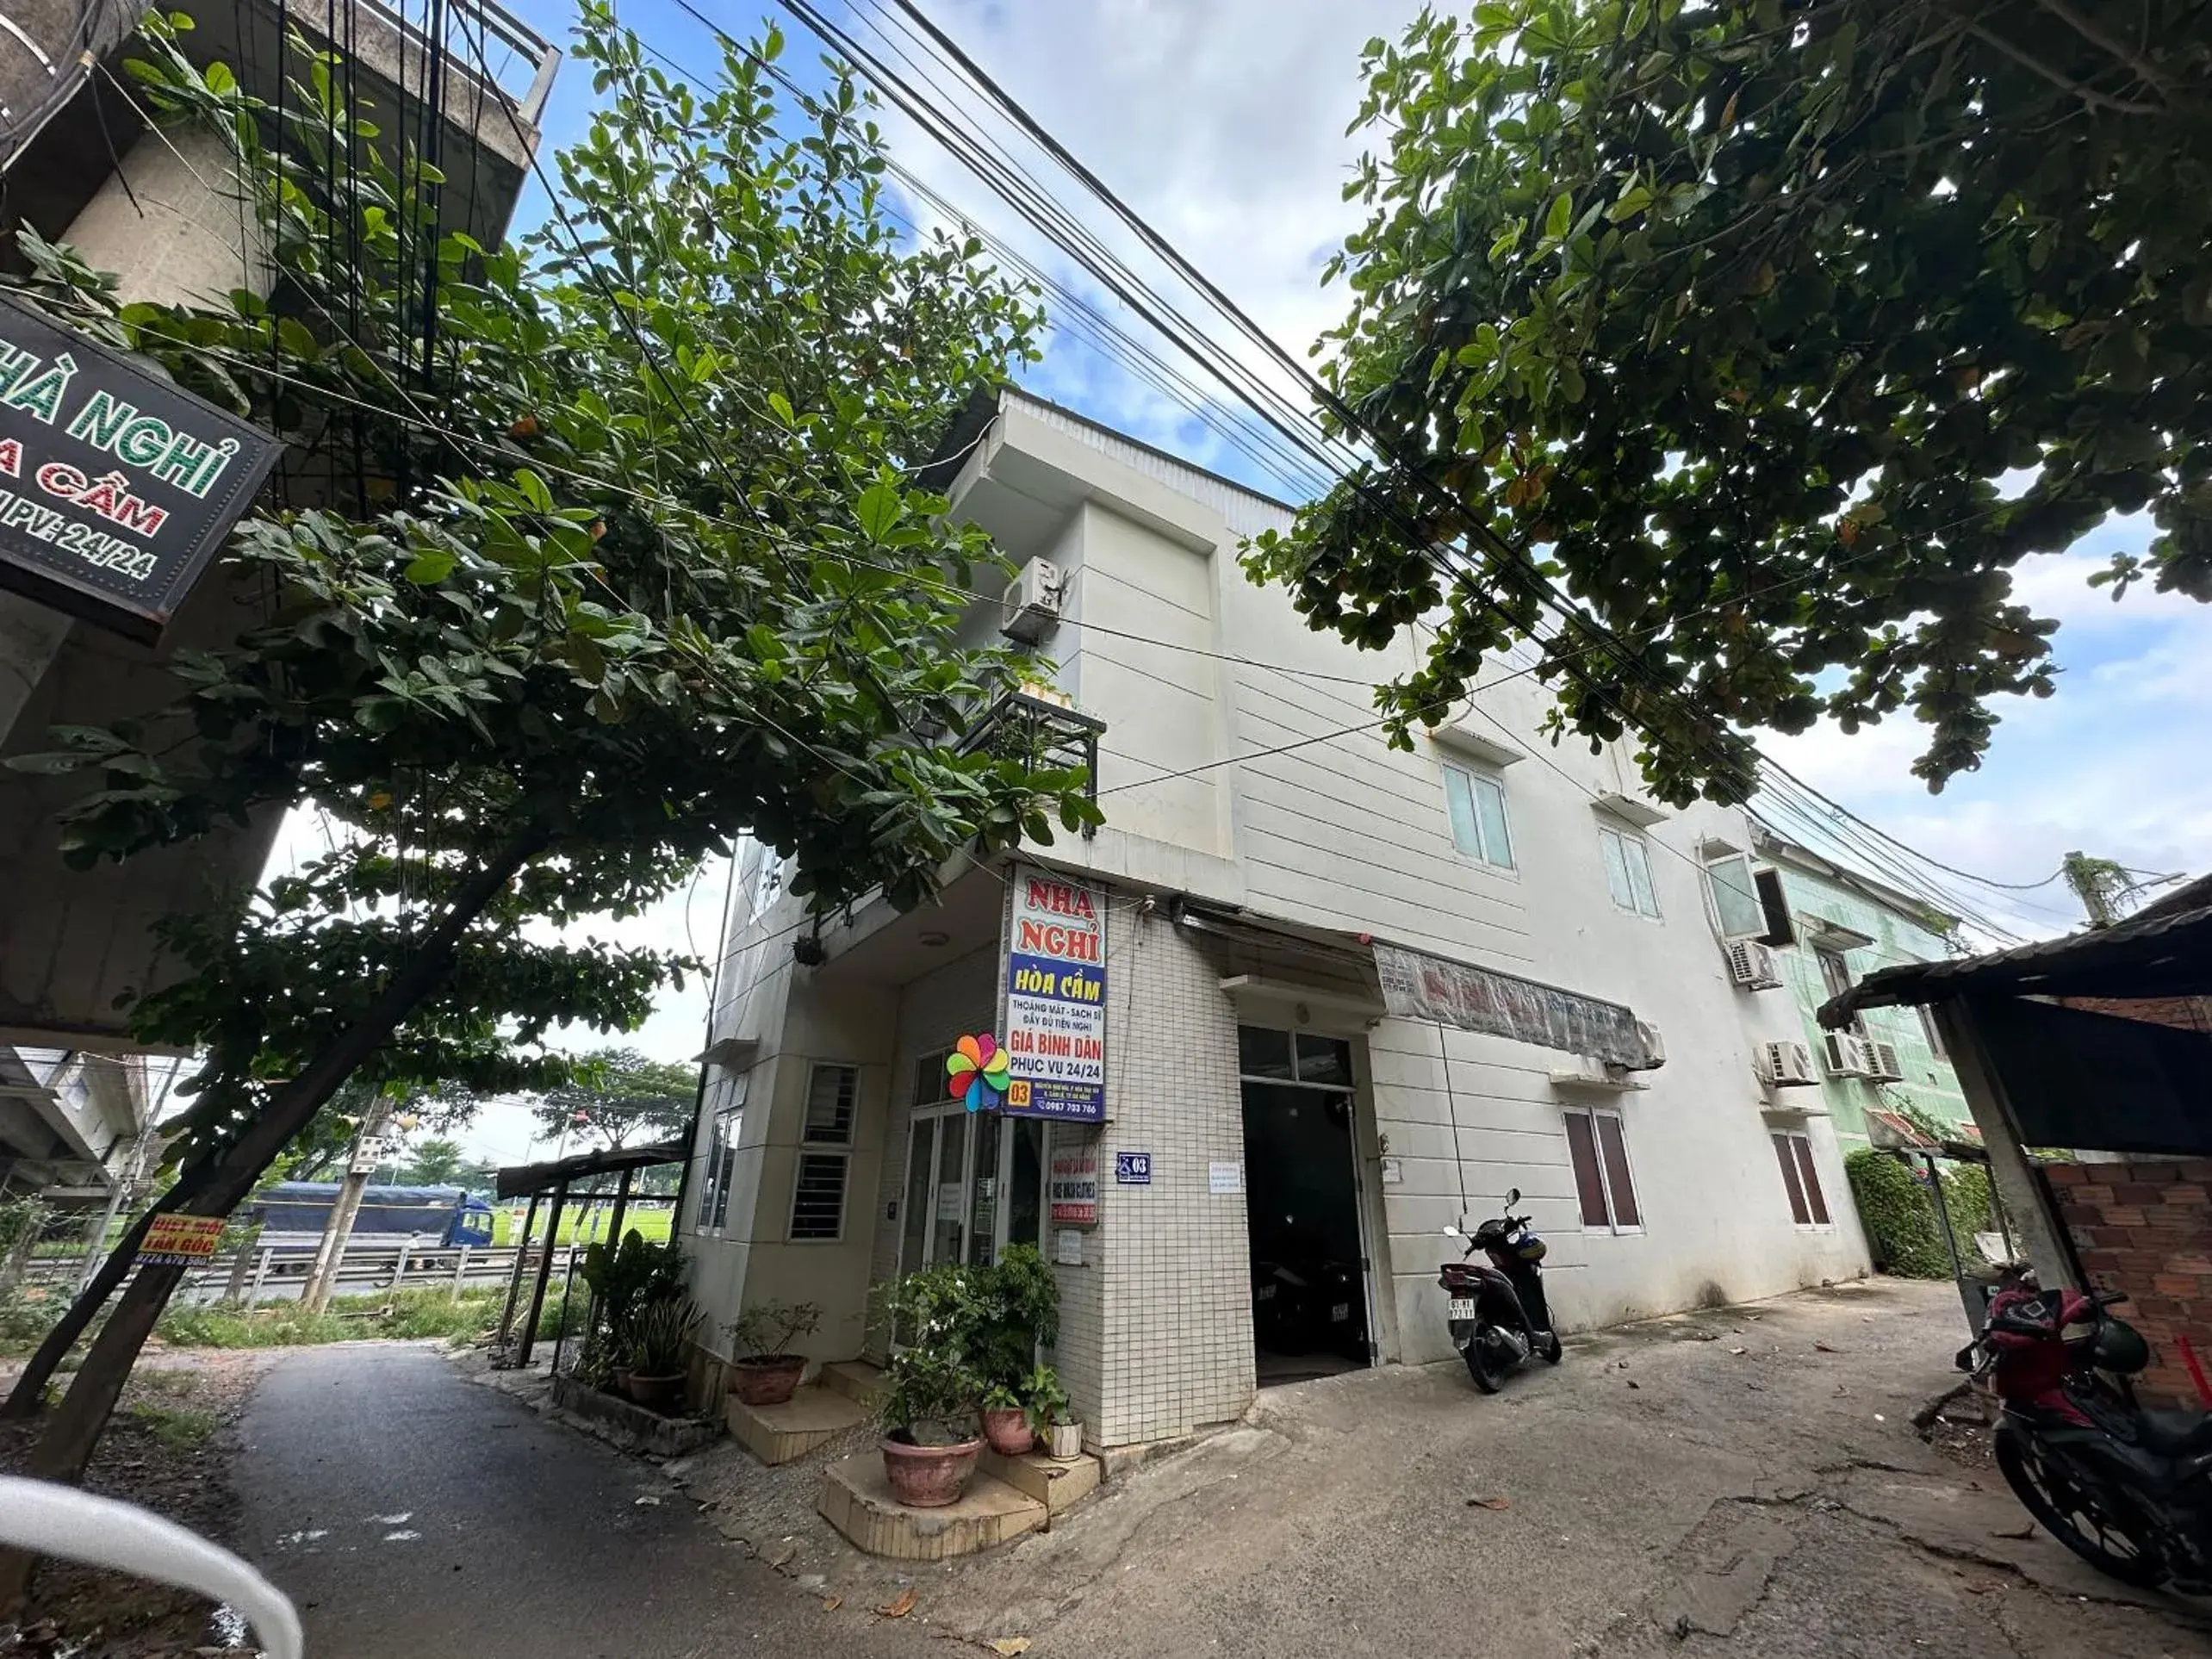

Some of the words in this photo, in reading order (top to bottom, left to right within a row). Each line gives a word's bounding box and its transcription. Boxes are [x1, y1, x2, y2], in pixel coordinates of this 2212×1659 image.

[65, 390, 240, 499] NGHỈ
[1019, 919, 1100, 962] NGHỈ
[1015, 964, 1055, 995] HÒA
[1060, 967, 1101, 1002] CẦM
[1013, 999, 1047, 1012] THOÁNG
[1010, 1028, 1034, 1053] GIÁ
[1038, 1030, 1071, 1057] BÌNH
[1074, 1035, 1102, 1060] DÂN
[1010, 1057, 1044, 1076] PHỤC
[1047, 1061, 1064, 1078] VỤ
[1066, 1063, 1100, 1078] 24/24
[1010, 1084, 1028, 1103] 03
[1132, 1158, 1146, 1173] 03
